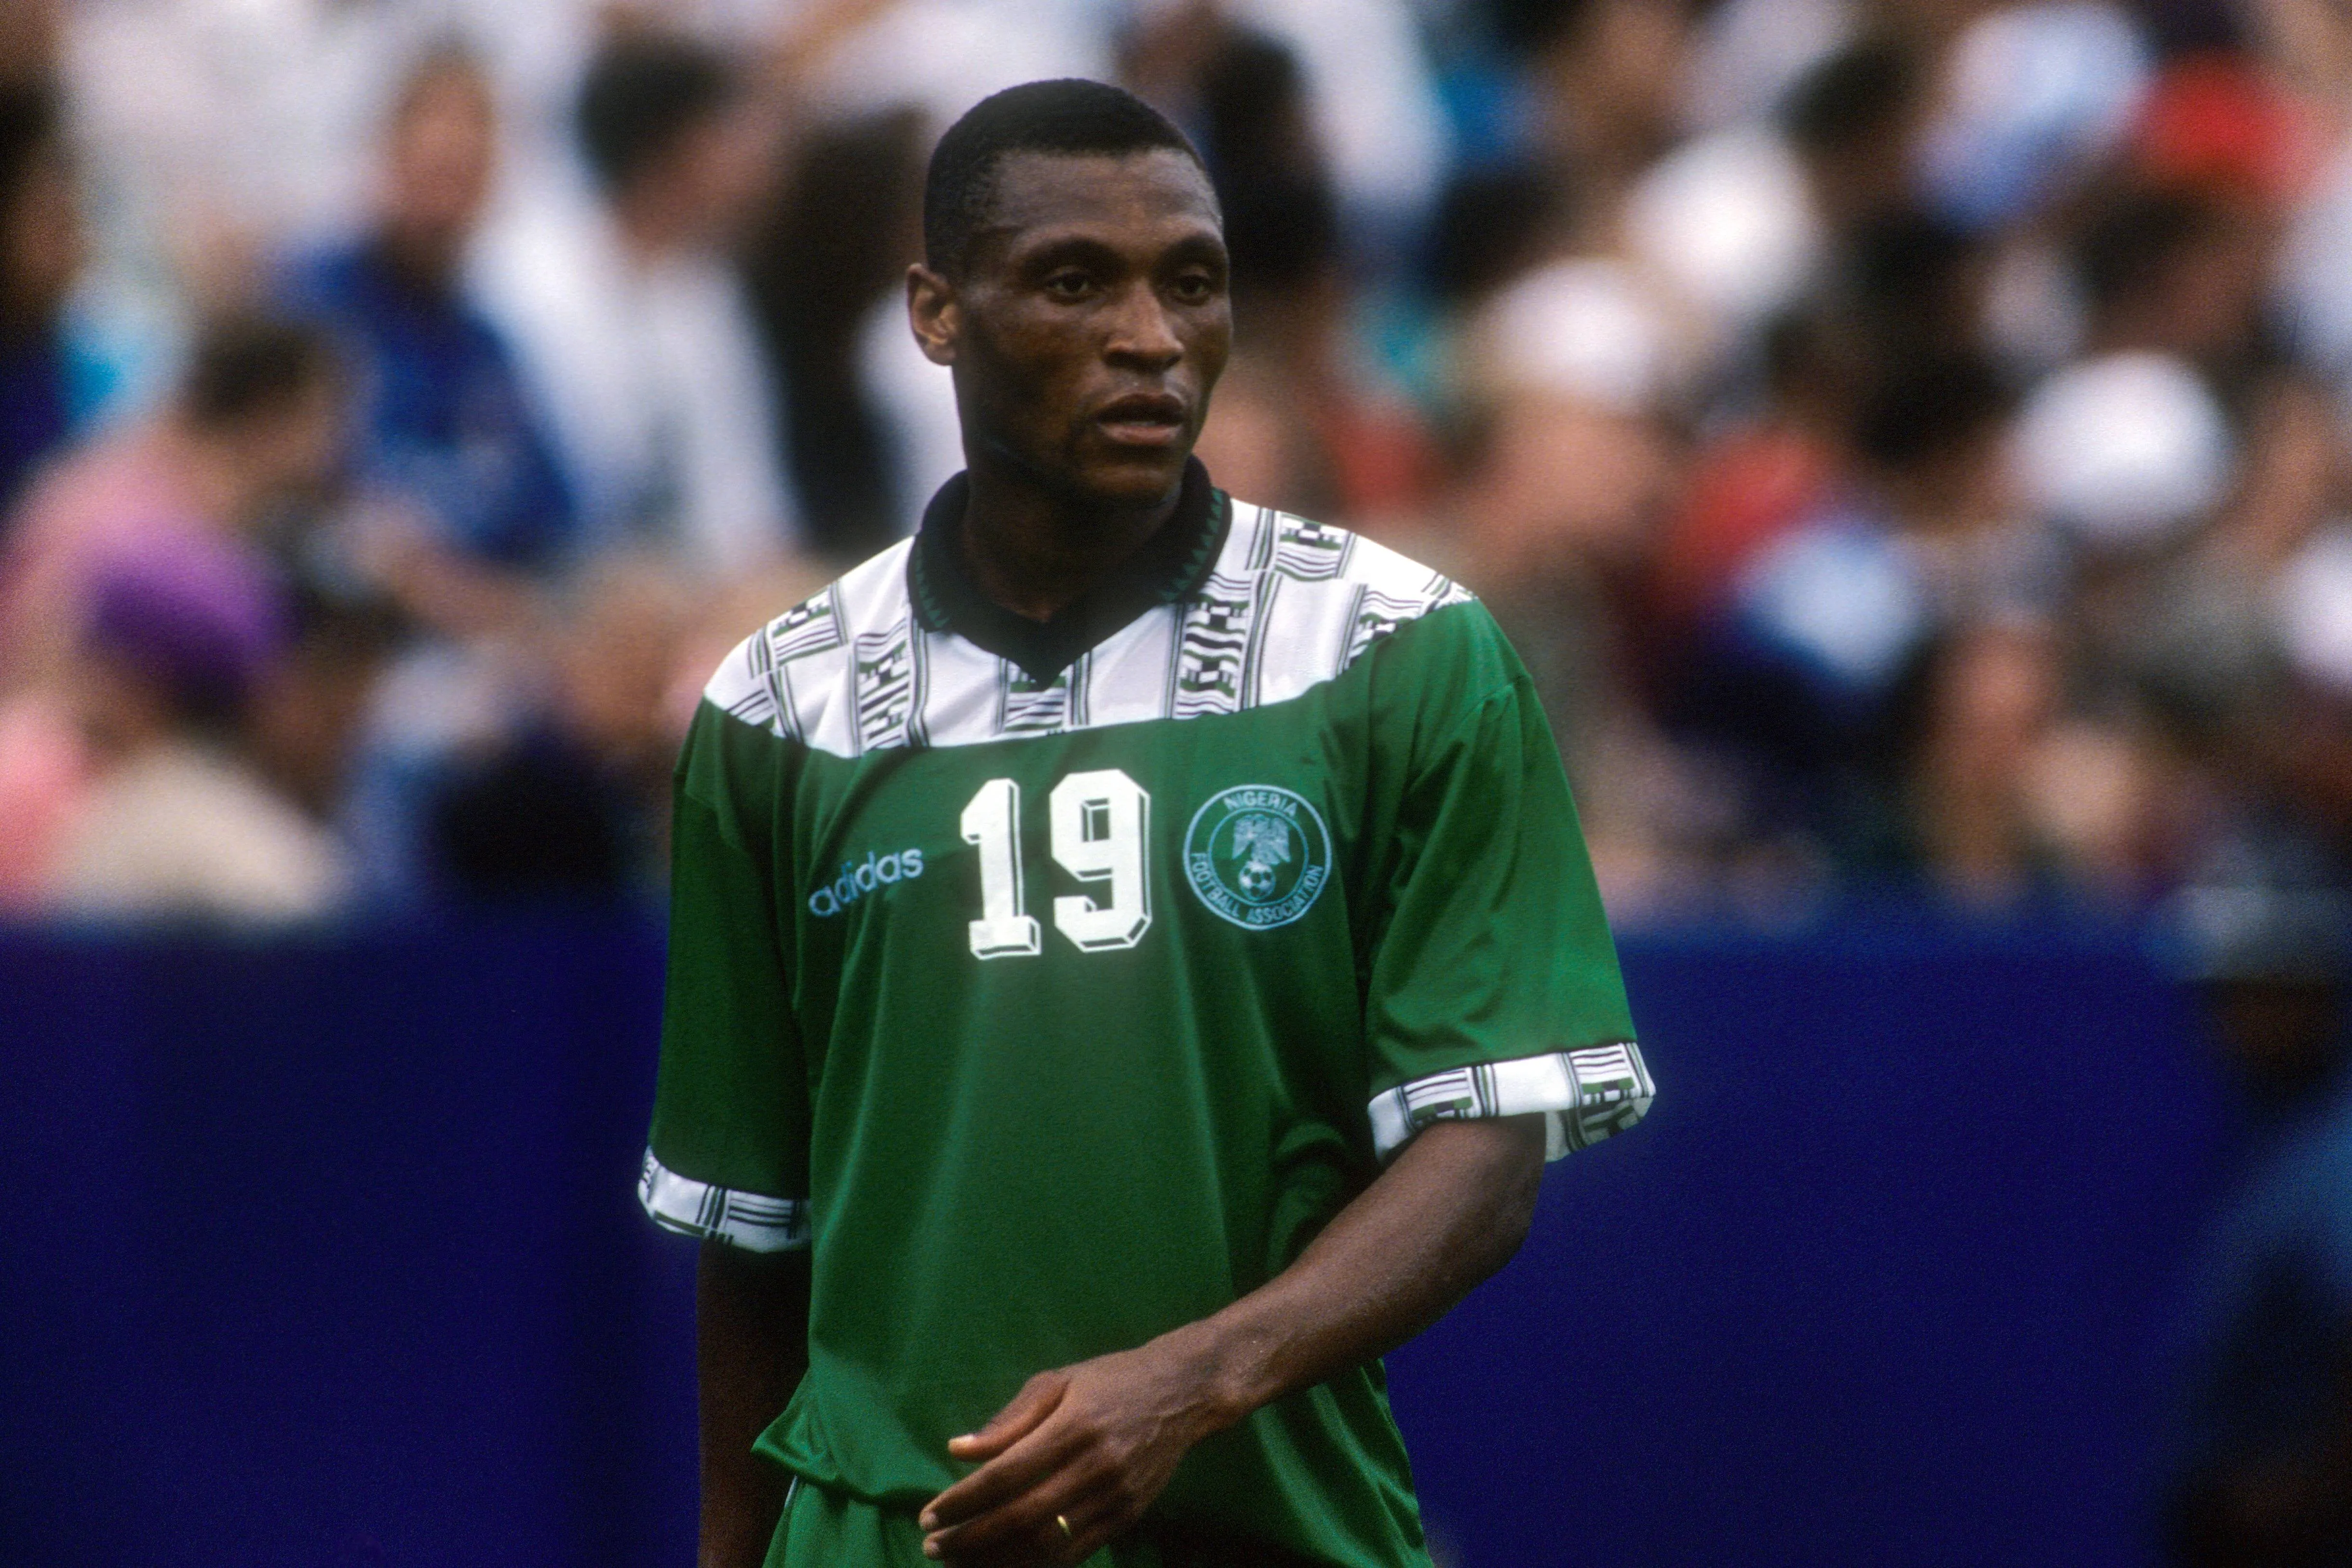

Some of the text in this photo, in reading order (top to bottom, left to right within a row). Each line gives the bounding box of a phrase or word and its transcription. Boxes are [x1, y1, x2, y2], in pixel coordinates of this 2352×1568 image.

[1223, 791, 1298, 817] NIGERIA
[808, 848, 923, 916] adidas
[960, 769, 1152, 960] 19
[1190, 852, 1324, 923] FOOTBALL ASSOCIATION
